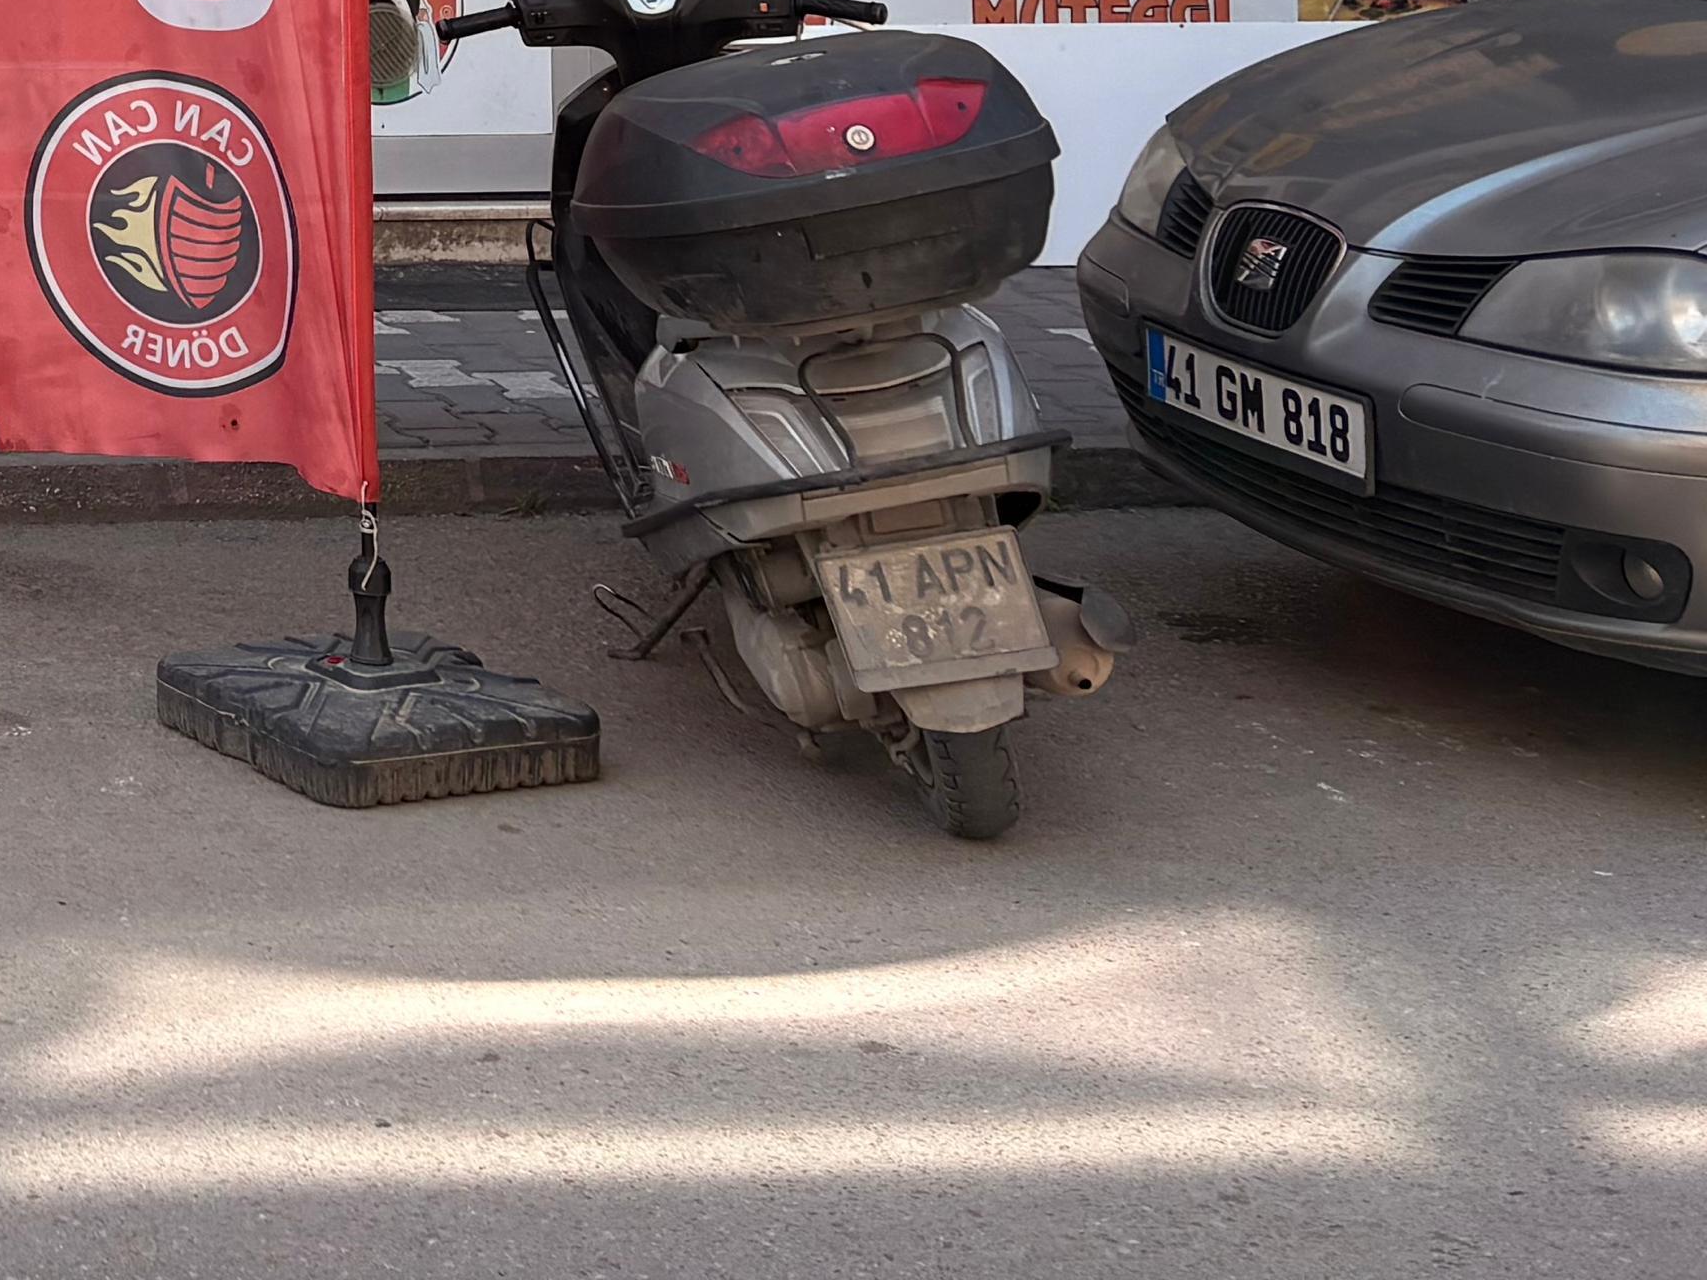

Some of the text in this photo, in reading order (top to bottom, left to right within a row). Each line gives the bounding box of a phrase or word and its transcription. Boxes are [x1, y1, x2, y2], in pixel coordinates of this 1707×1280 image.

[1166, 344, 1201, 410] 41
[1215, 364, 1266, 434] GM
[1282, 387, 1351, 464] 818
[839, 540, 1018, 607] 41 APN
[901, 606, 995, 658] 812
